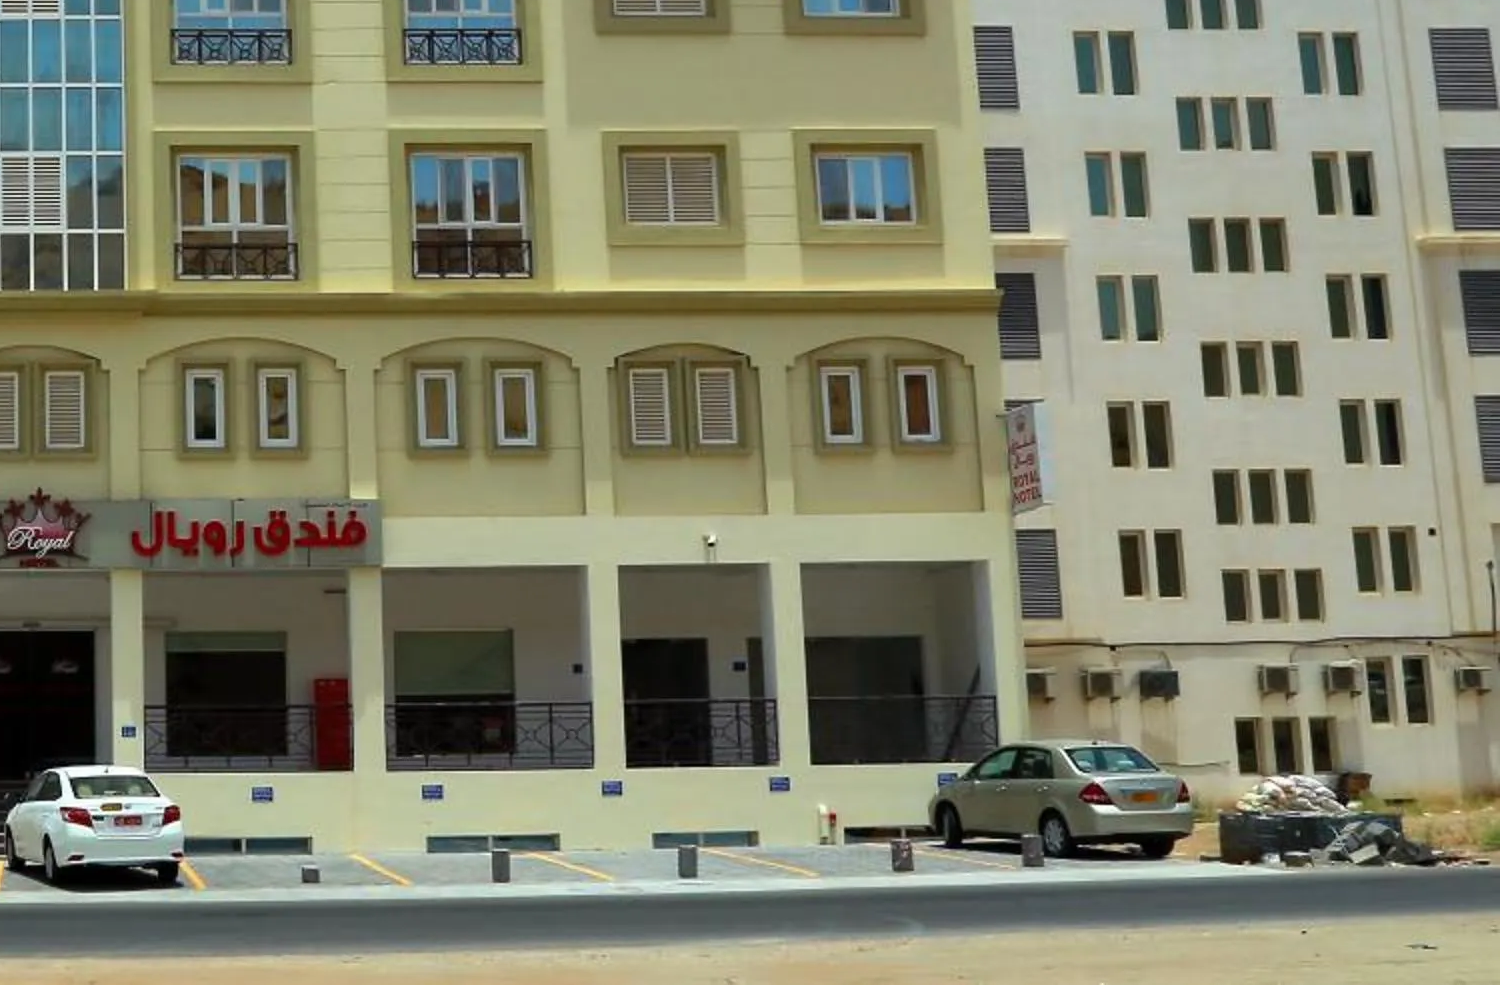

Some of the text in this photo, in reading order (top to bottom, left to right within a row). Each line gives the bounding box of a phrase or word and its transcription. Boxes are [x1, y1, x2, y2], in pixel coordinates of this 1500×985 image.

[7, 526, 75, 559] Royal
[131, 510, 367, 558] فندق رويال
